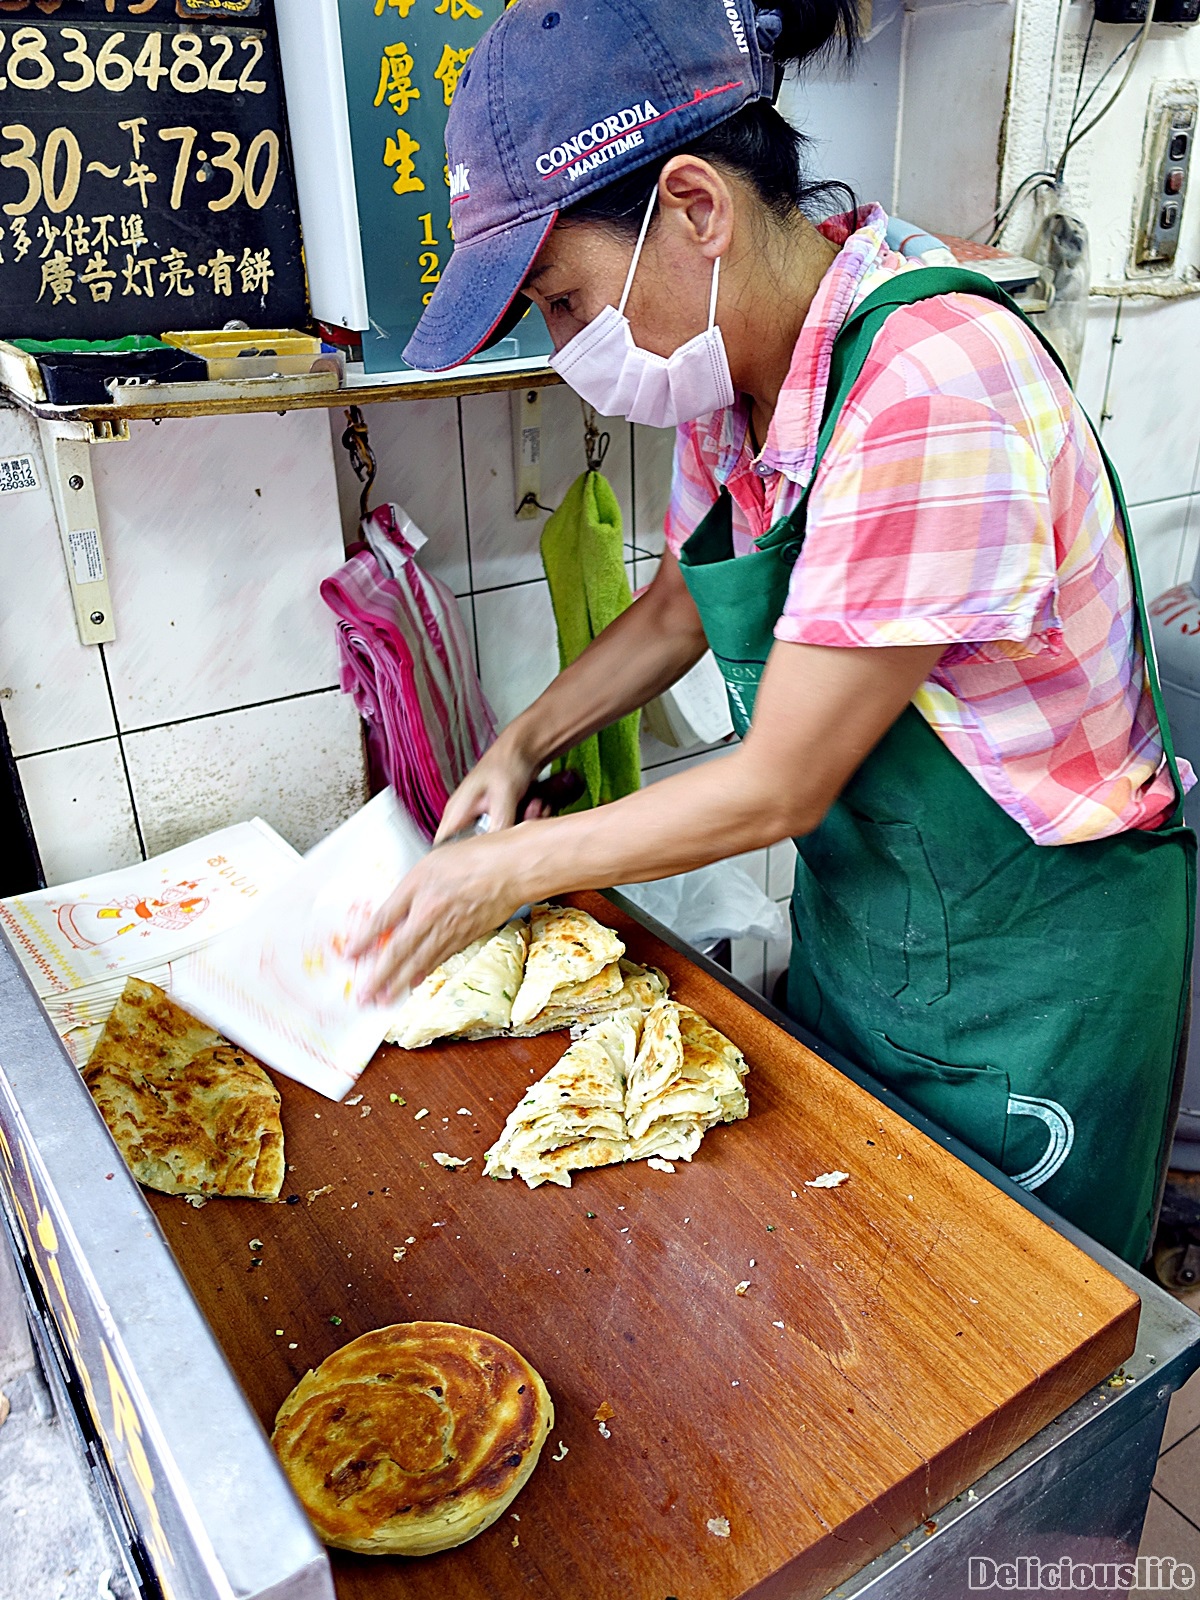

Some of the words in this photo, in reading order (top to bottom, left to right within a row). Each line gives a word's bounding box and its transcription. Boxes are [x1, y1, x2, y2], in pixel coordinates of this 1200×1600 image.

[0, 26, 266, 93] 8364822
[535, 99, 660, 175] CONCORDIA
[565, 130, 645, 181] MARITIME
[0, 214, 148, 263] 多少估不準
